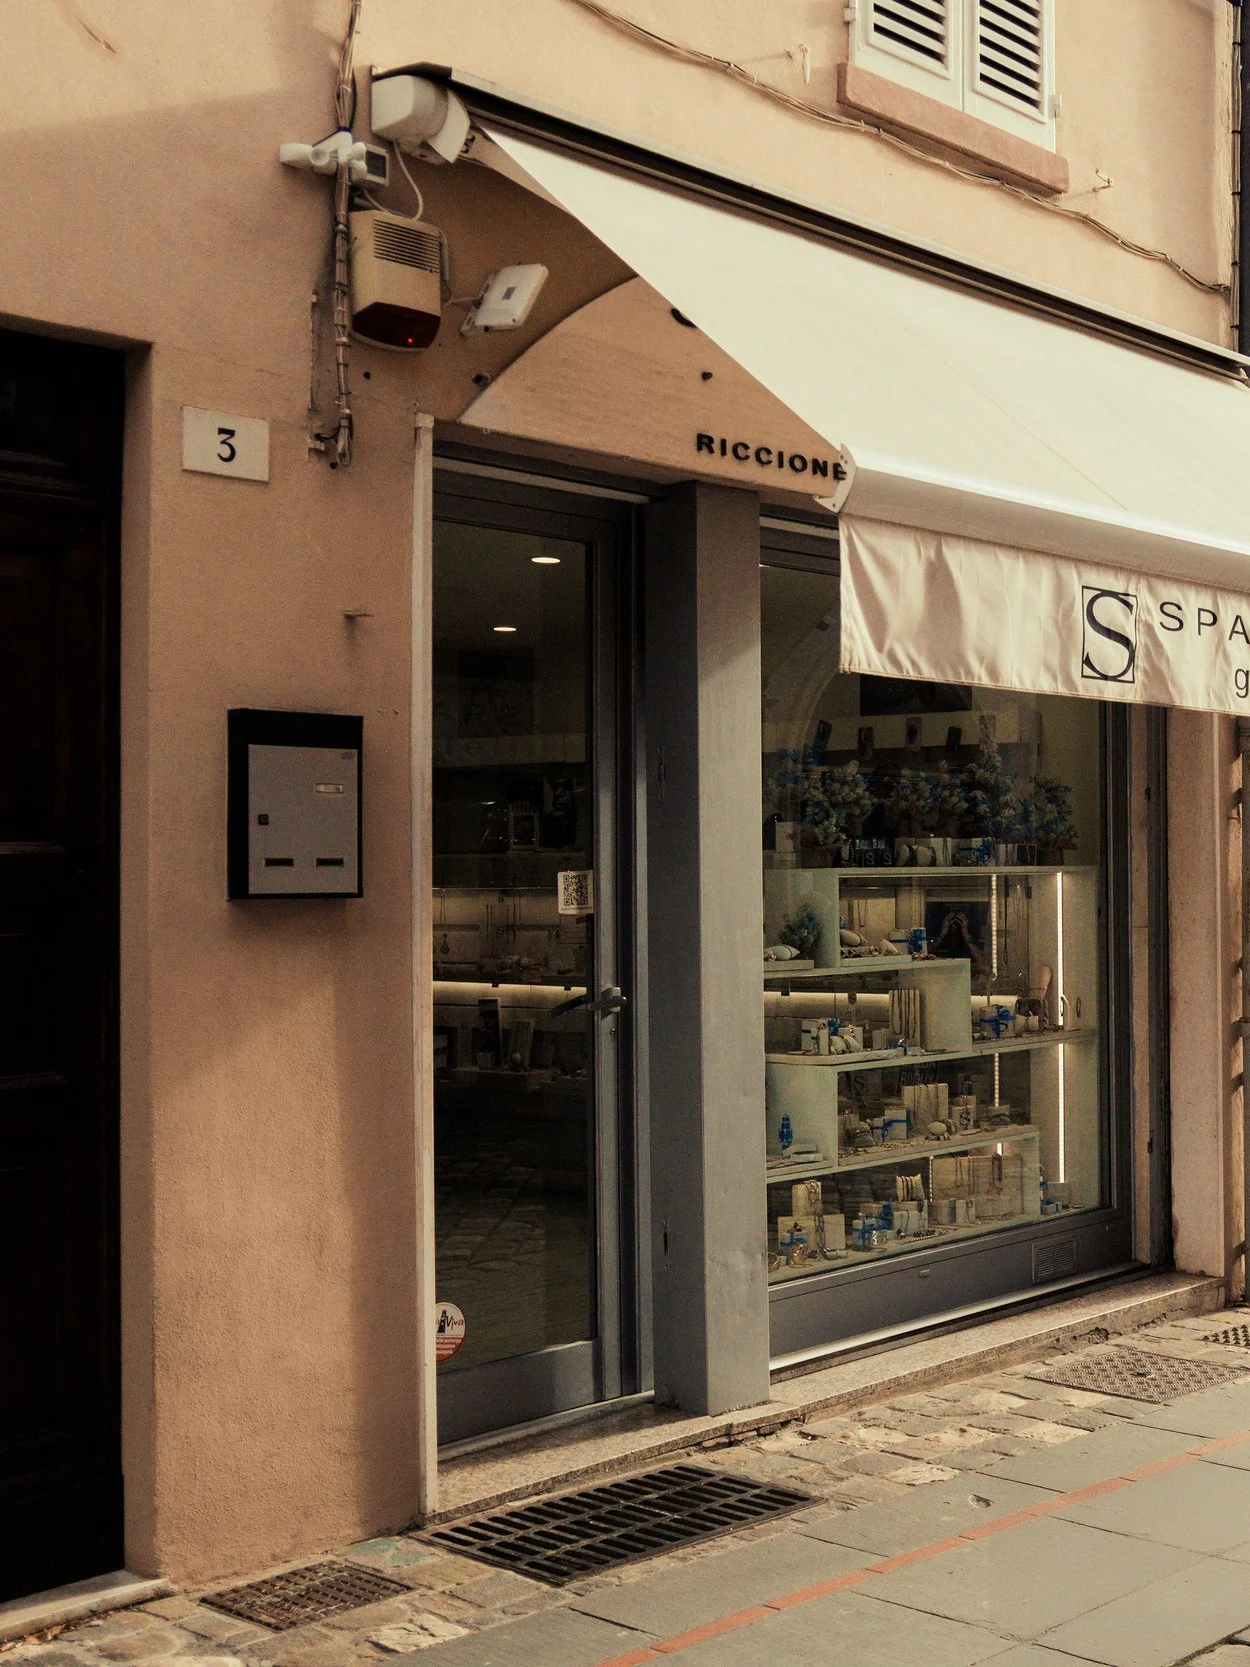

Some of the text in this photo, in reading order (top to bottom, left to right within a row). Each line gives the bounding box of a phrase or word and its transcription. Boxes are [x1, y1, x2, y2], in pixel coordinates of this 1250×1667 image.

[216, 427, 237, 463] 3
[696, 432, 848, 481] RICCIONE
[1082, 590, 1136, 681] S
